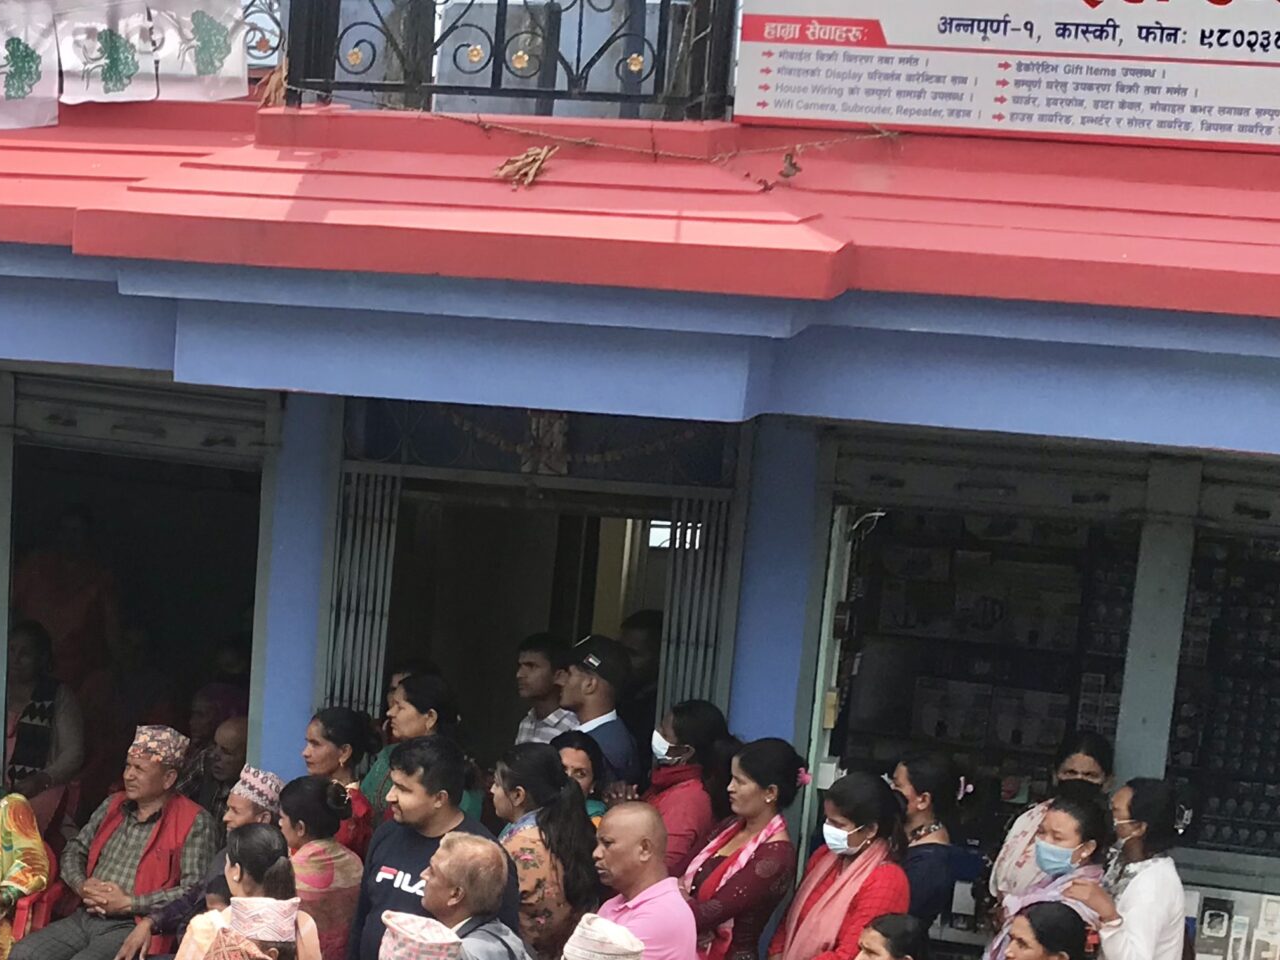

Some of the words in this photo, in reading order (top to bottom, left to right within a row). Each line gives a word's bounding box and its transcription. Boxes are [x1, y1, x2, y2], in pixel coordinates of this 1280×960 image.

[1055, 18, 1123, 46] कास्की,
[825, 68, 864, 82] Display
[1063, 64, 1083, 75] Gift
[1085, 66, 1117, 76] Items
[775, 83, 809, 94] House
[811, 84, 844, 98] Wiring
[773, 99, 794, 109] Wifi
